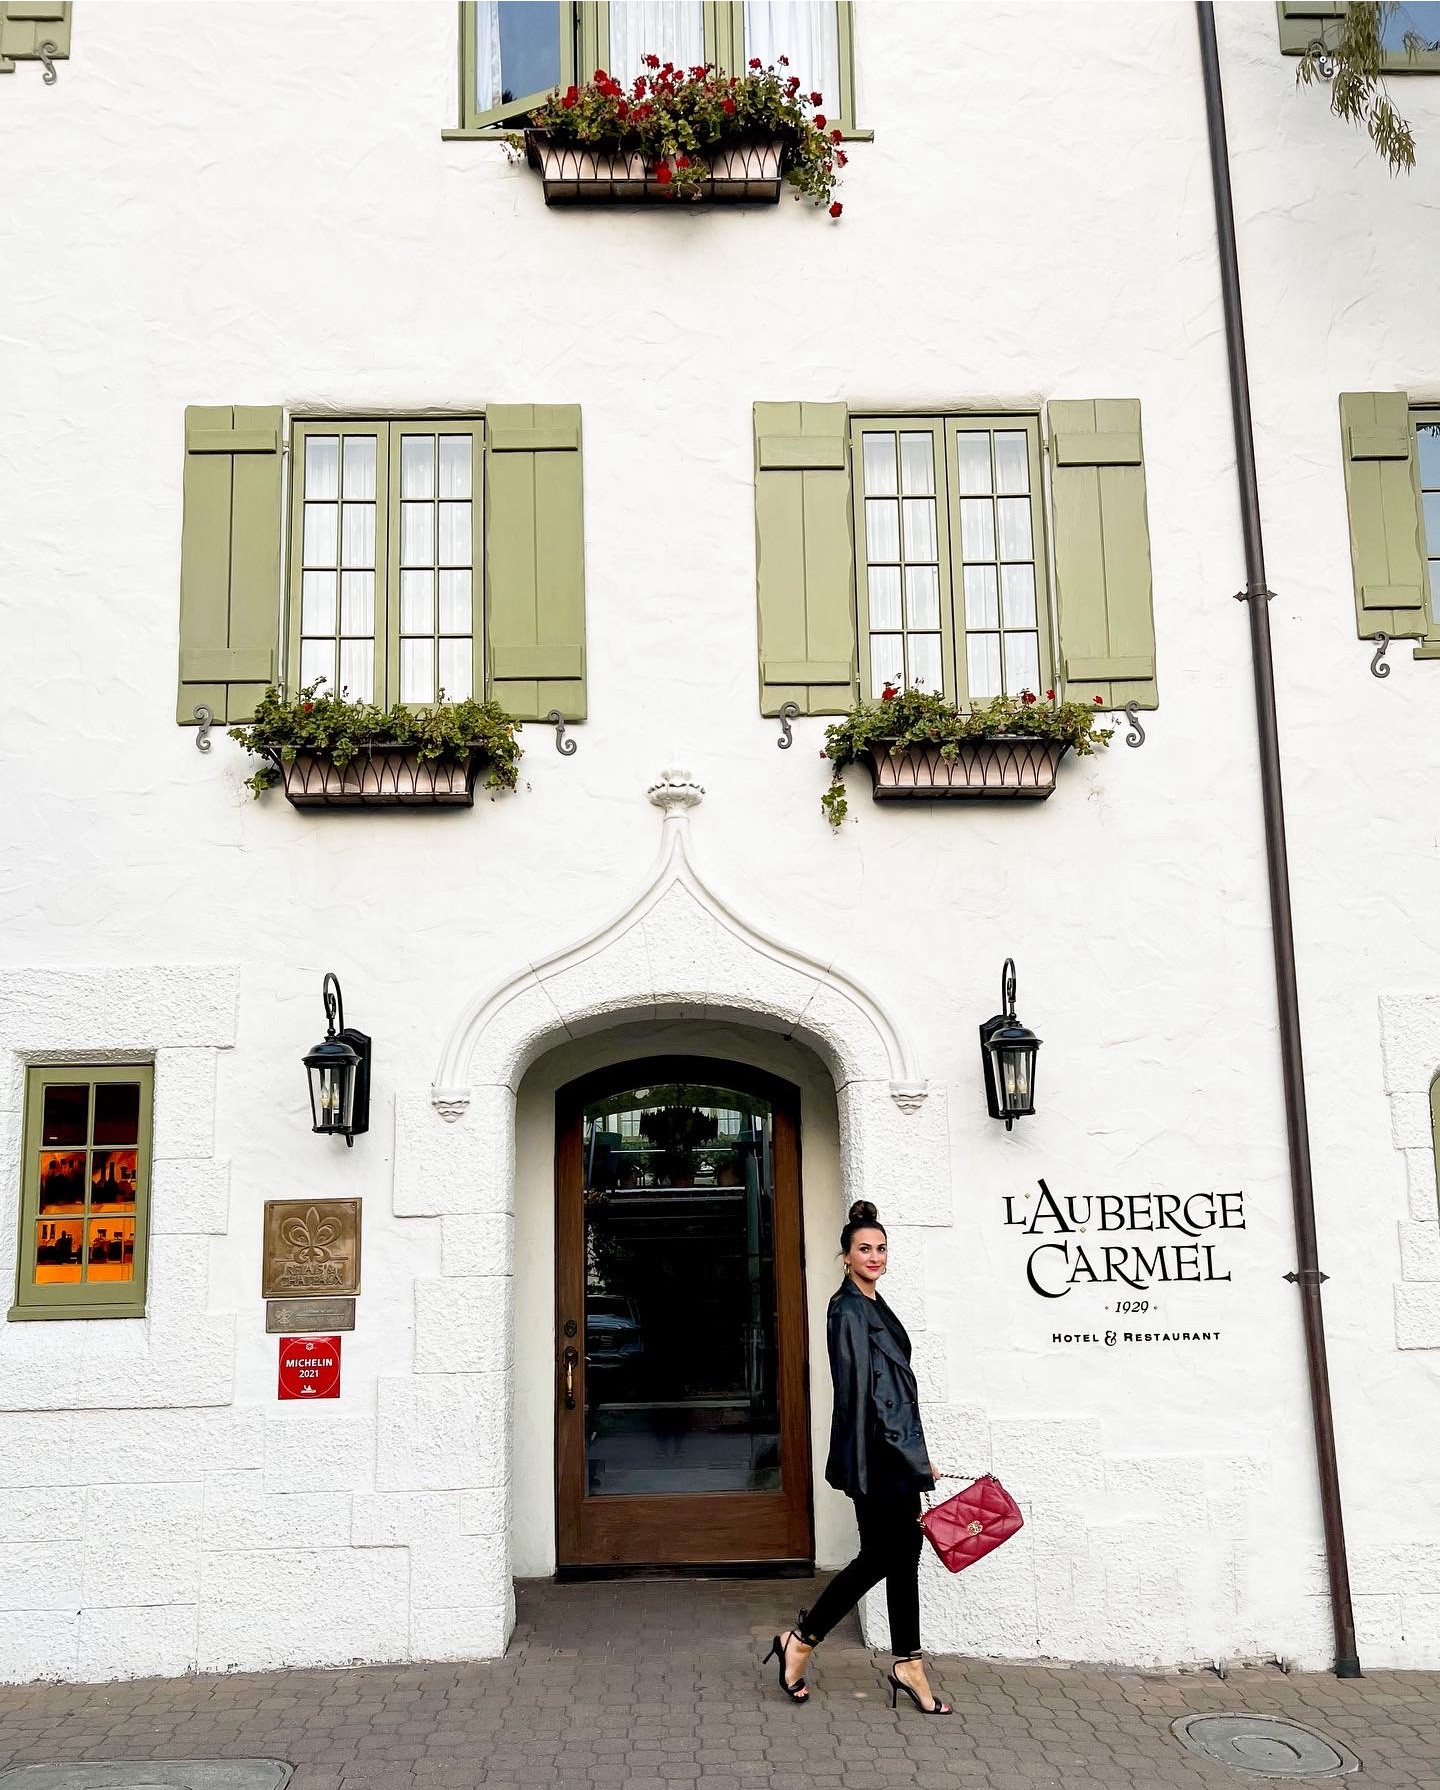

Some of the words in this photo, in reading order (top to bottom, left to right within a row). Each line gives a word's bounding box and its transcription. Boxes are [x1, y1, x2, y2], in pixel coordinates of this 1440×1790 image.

[1027, 1240, 1232, 1298] CARMEL
[1115, 1300, 1150, 1314] 1929
[1104, 1330, 1118, 1347] &
[285, 1358, 333, 1368] MICHELIN
[299, 1369, 320, 1378] 2021
